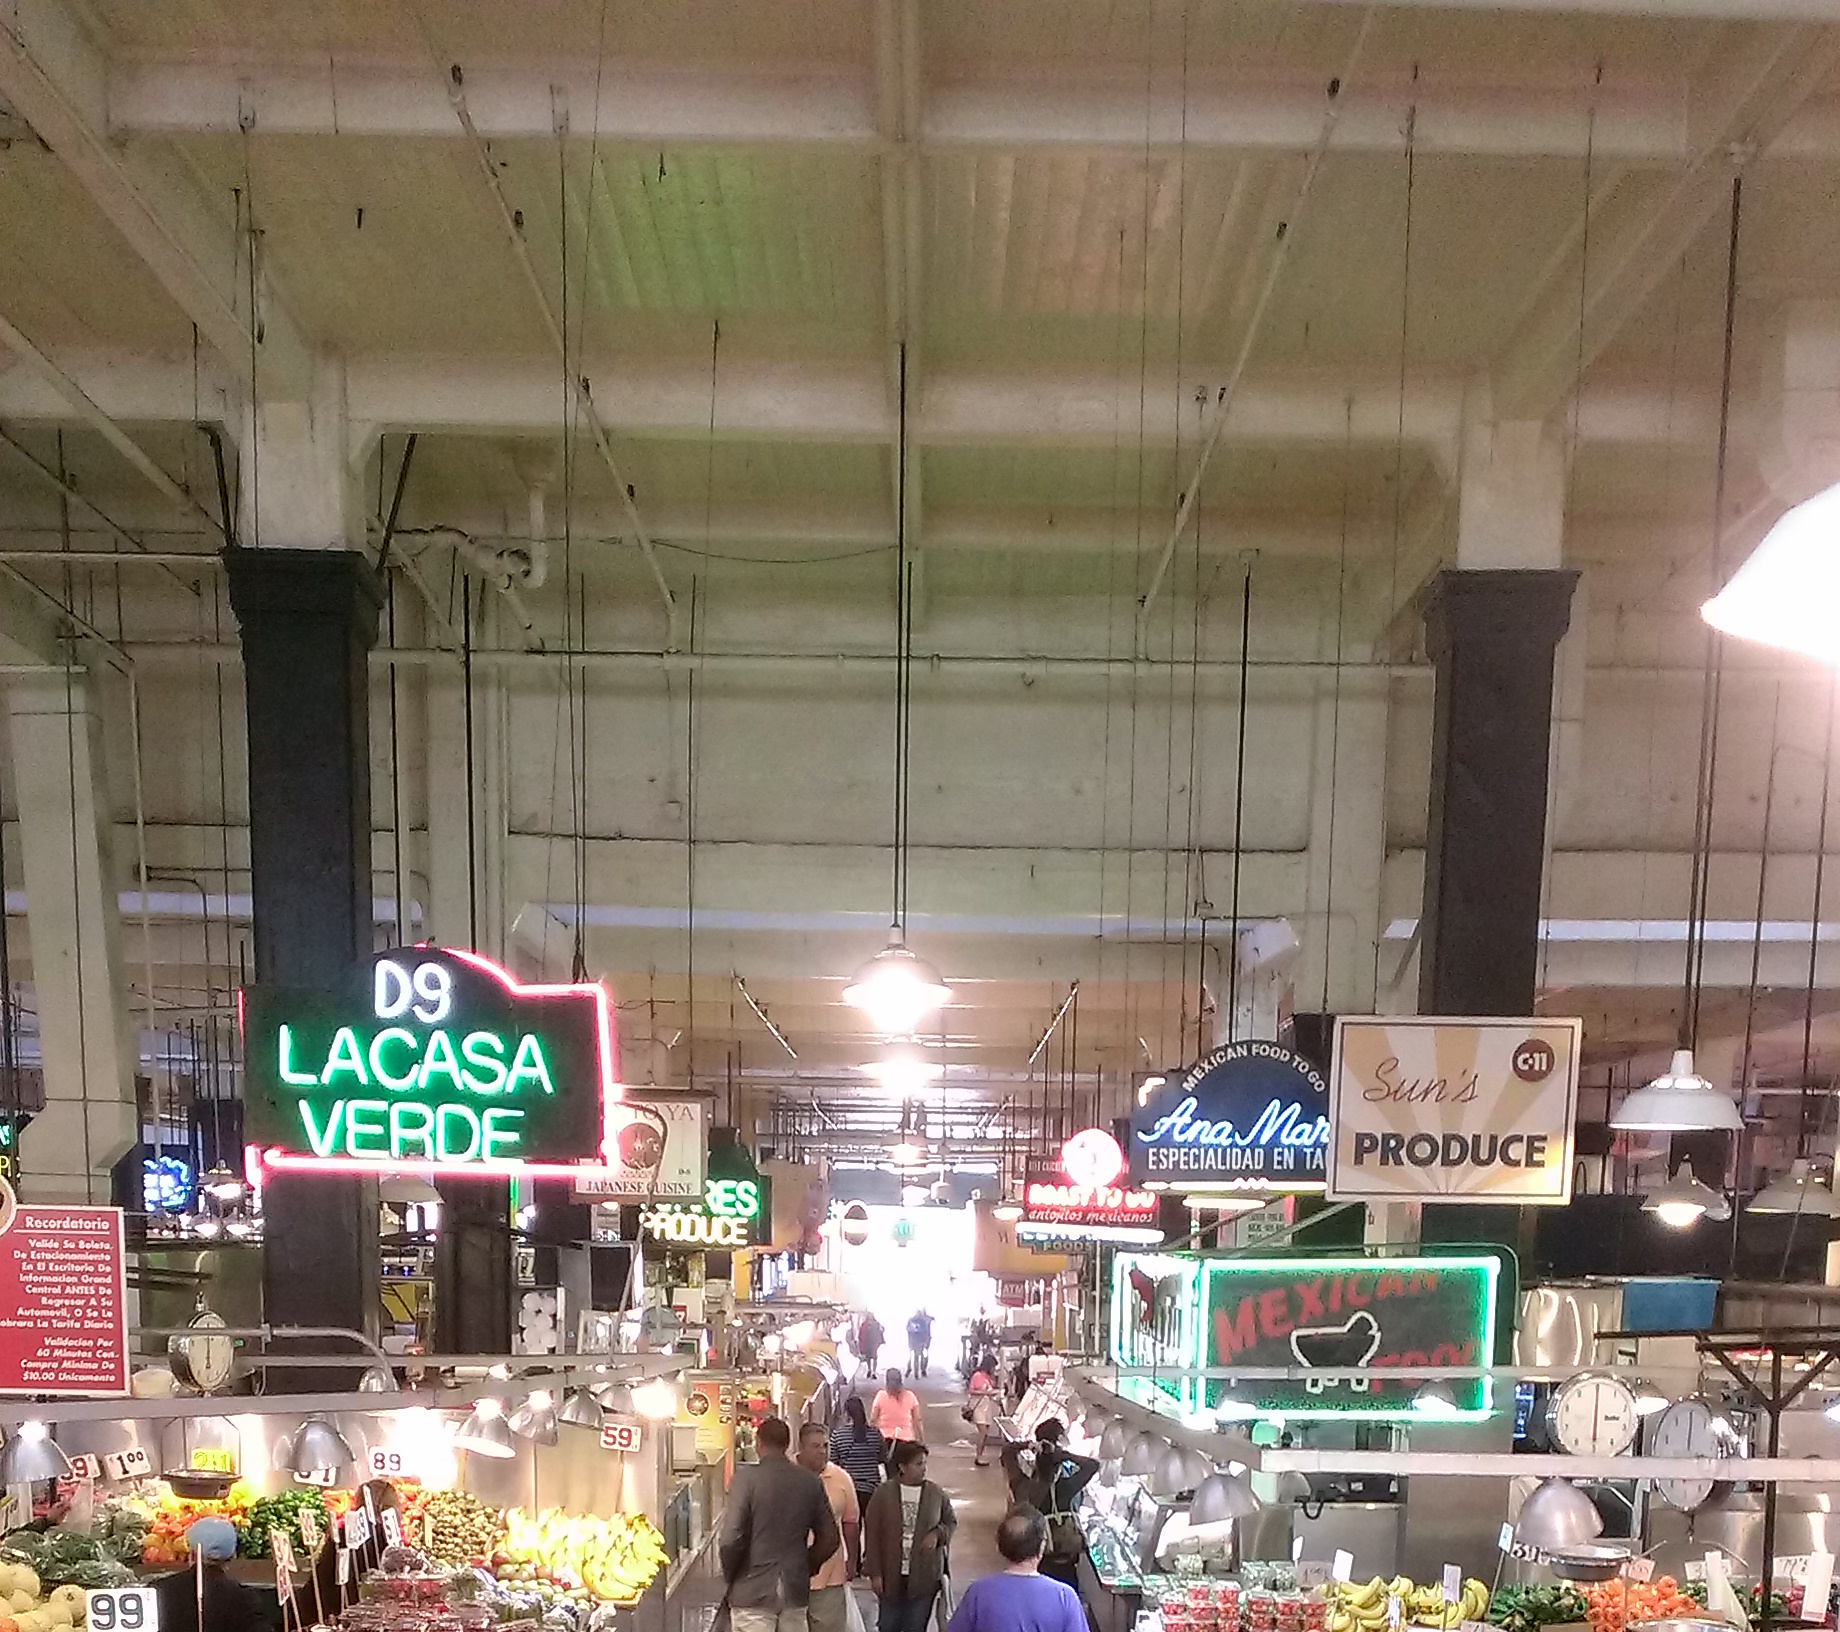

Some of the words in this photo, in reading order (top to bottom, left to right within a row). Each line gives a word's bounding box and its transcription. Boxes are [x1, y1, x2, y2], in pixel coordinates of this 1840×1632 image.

[374, 959, 451, 1023] D9
[1182, 1043, 1248, 1093] MEXICAN
[1251, 1043, 1291, 1063] FOOD
[1292, 1054, 1310, 1074] TO
[1307, 1070, 1326, 1093] GO
[1362, 1056, 1480, 1103] Sun's
[1137, 1096, 1234, 1146] Ana
[298, 1100, 526, 1165] VERDE
[1353, 1132, 1549, 1168] PRODUCE
[1148, 1147, 1264, 1170] ESPECIALIDAD
[1273, 1148, 1294, 1170] EN
[585, 1181, 644, 1194] JAPANESE
[646, 1182, 694, 1196] CUISINE
[25, 1215, 110, 1230] Recordatorio
[638, 1211, 750, 1246] PRODUCE
[28, 1239, 60, 1249] Valide
[62, 1239, 76, 1249] Su
[13, 1250, 27, 1260] De
[30, 1250, 111, 1261] Estacionamiento
[22, 1261, 34, 1271] En
[36, 1261, 46, 1271] El
[48, 1262, 95, 1272] Escritorio
[97, 1263, 112, 1273] De
[19, 1273, 78, 1282] Informacion
[81, 1274, 112, 1284] Grand
[25, 1284, 62, 1294] Central
[64, 1285, 96, 1295] ANTES
[98, 1286, 113, 1296] De
[41, 1296, 87, 1307] Regresar
[89, 1297, 98, 1306] A
[100, 1297, 114, 1307] Su
[73, 1308, 83, 1318] O
[86, 1308, 99, 1318] Se
[101, 1309, 114, 1318] Le
[1213, 1273, 1438, 1366] MEXICAN
[37, 1319, 49, 1328] La
[51, 1319, 81, 1329] Tarifa
[43, 1336, 94, 1347] Validacion
[36, 1347, 51, 1357] 60
[52, 1348, 93, 1358] Minutos
[20, 1358, 59, 1370] Compra
[61, 1359, 99, 1369] Minima
[101, 1360, 116, 1370] De
[22, 1370, 56, 1381] $10.00
[58, 1371, 116, 1382] Unicamente
[603, 1425, 633, 1448] 59
[373, 1452, 401, 1472] 89
[91, 1592, 144, 1631] 99
